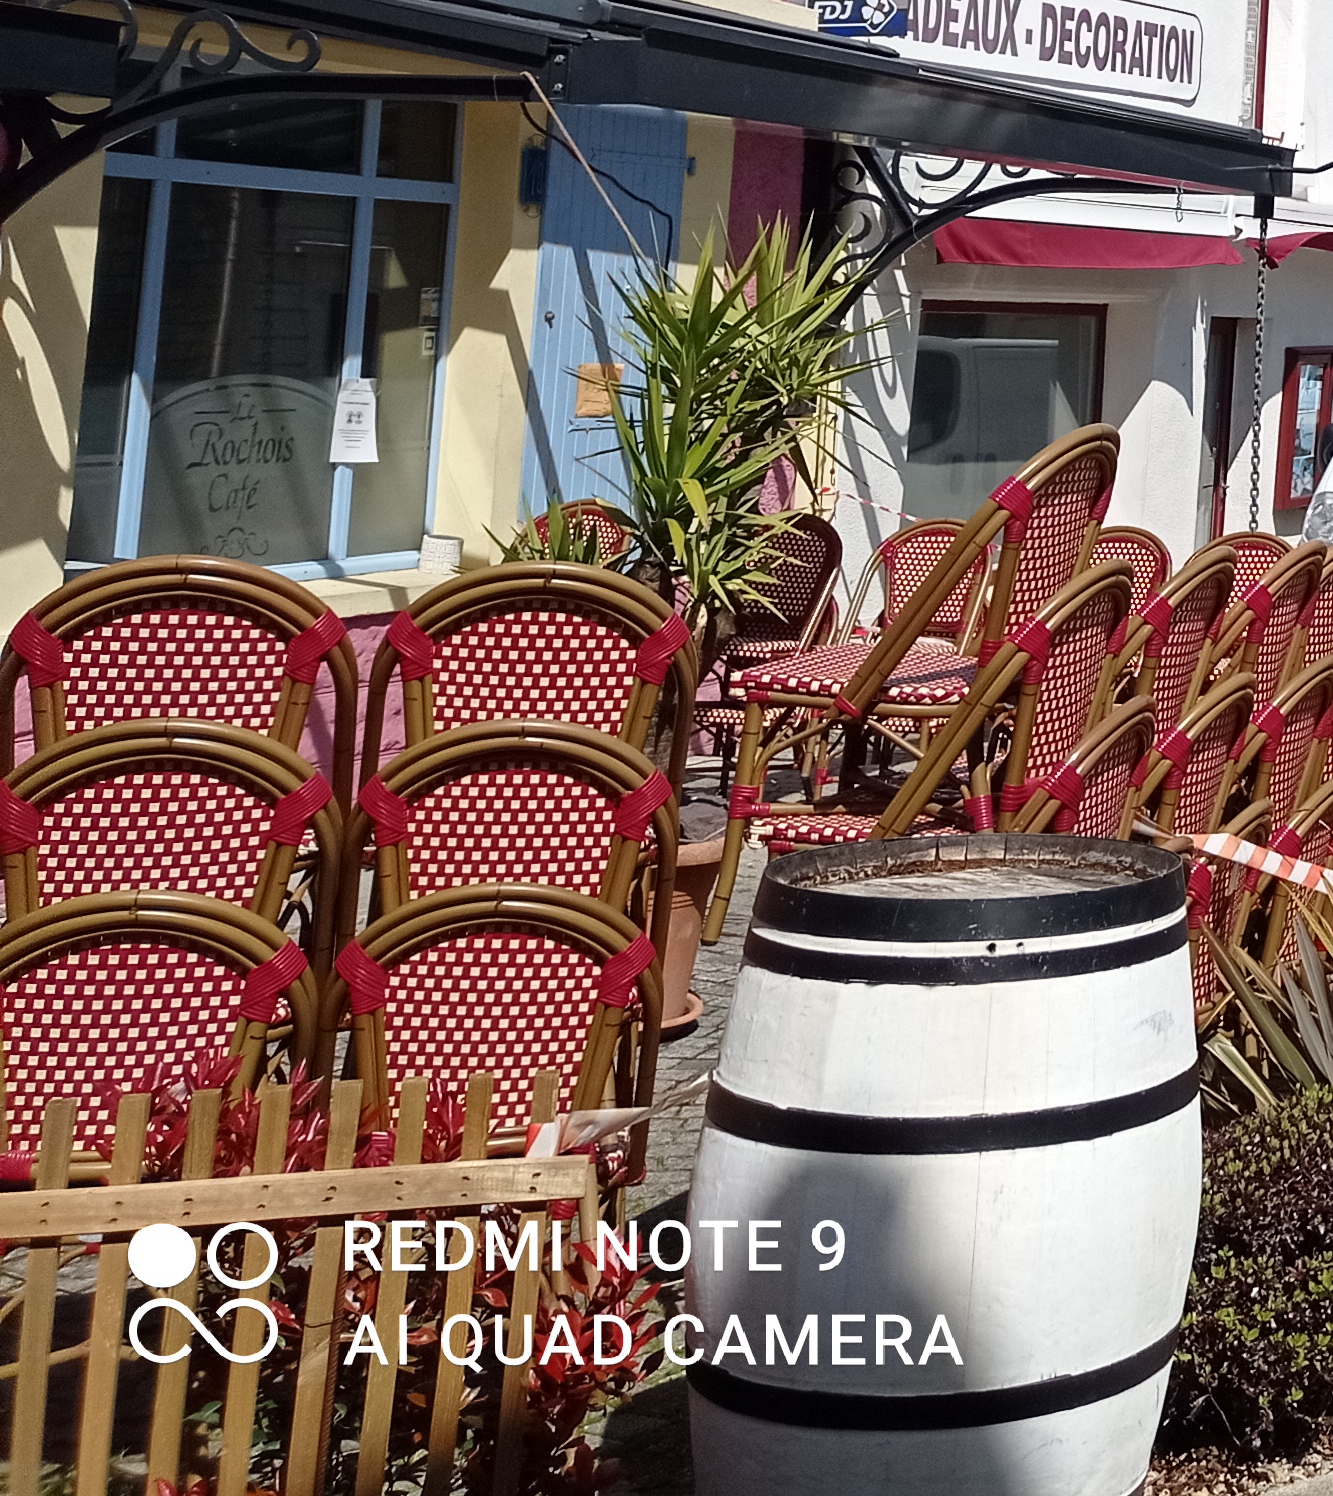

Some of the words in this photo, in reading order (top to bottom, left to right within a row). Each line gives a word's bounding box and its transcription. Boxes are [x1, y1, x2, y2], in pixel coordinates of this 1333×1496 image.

[813, 0, 854, 20] FDJ
[1039, 1, 1195, 85] DECORATION
[230, 393, 255, 423] Le
[186, 421, 295, 471] Rochois
[207, 473, 261, 522] Café
